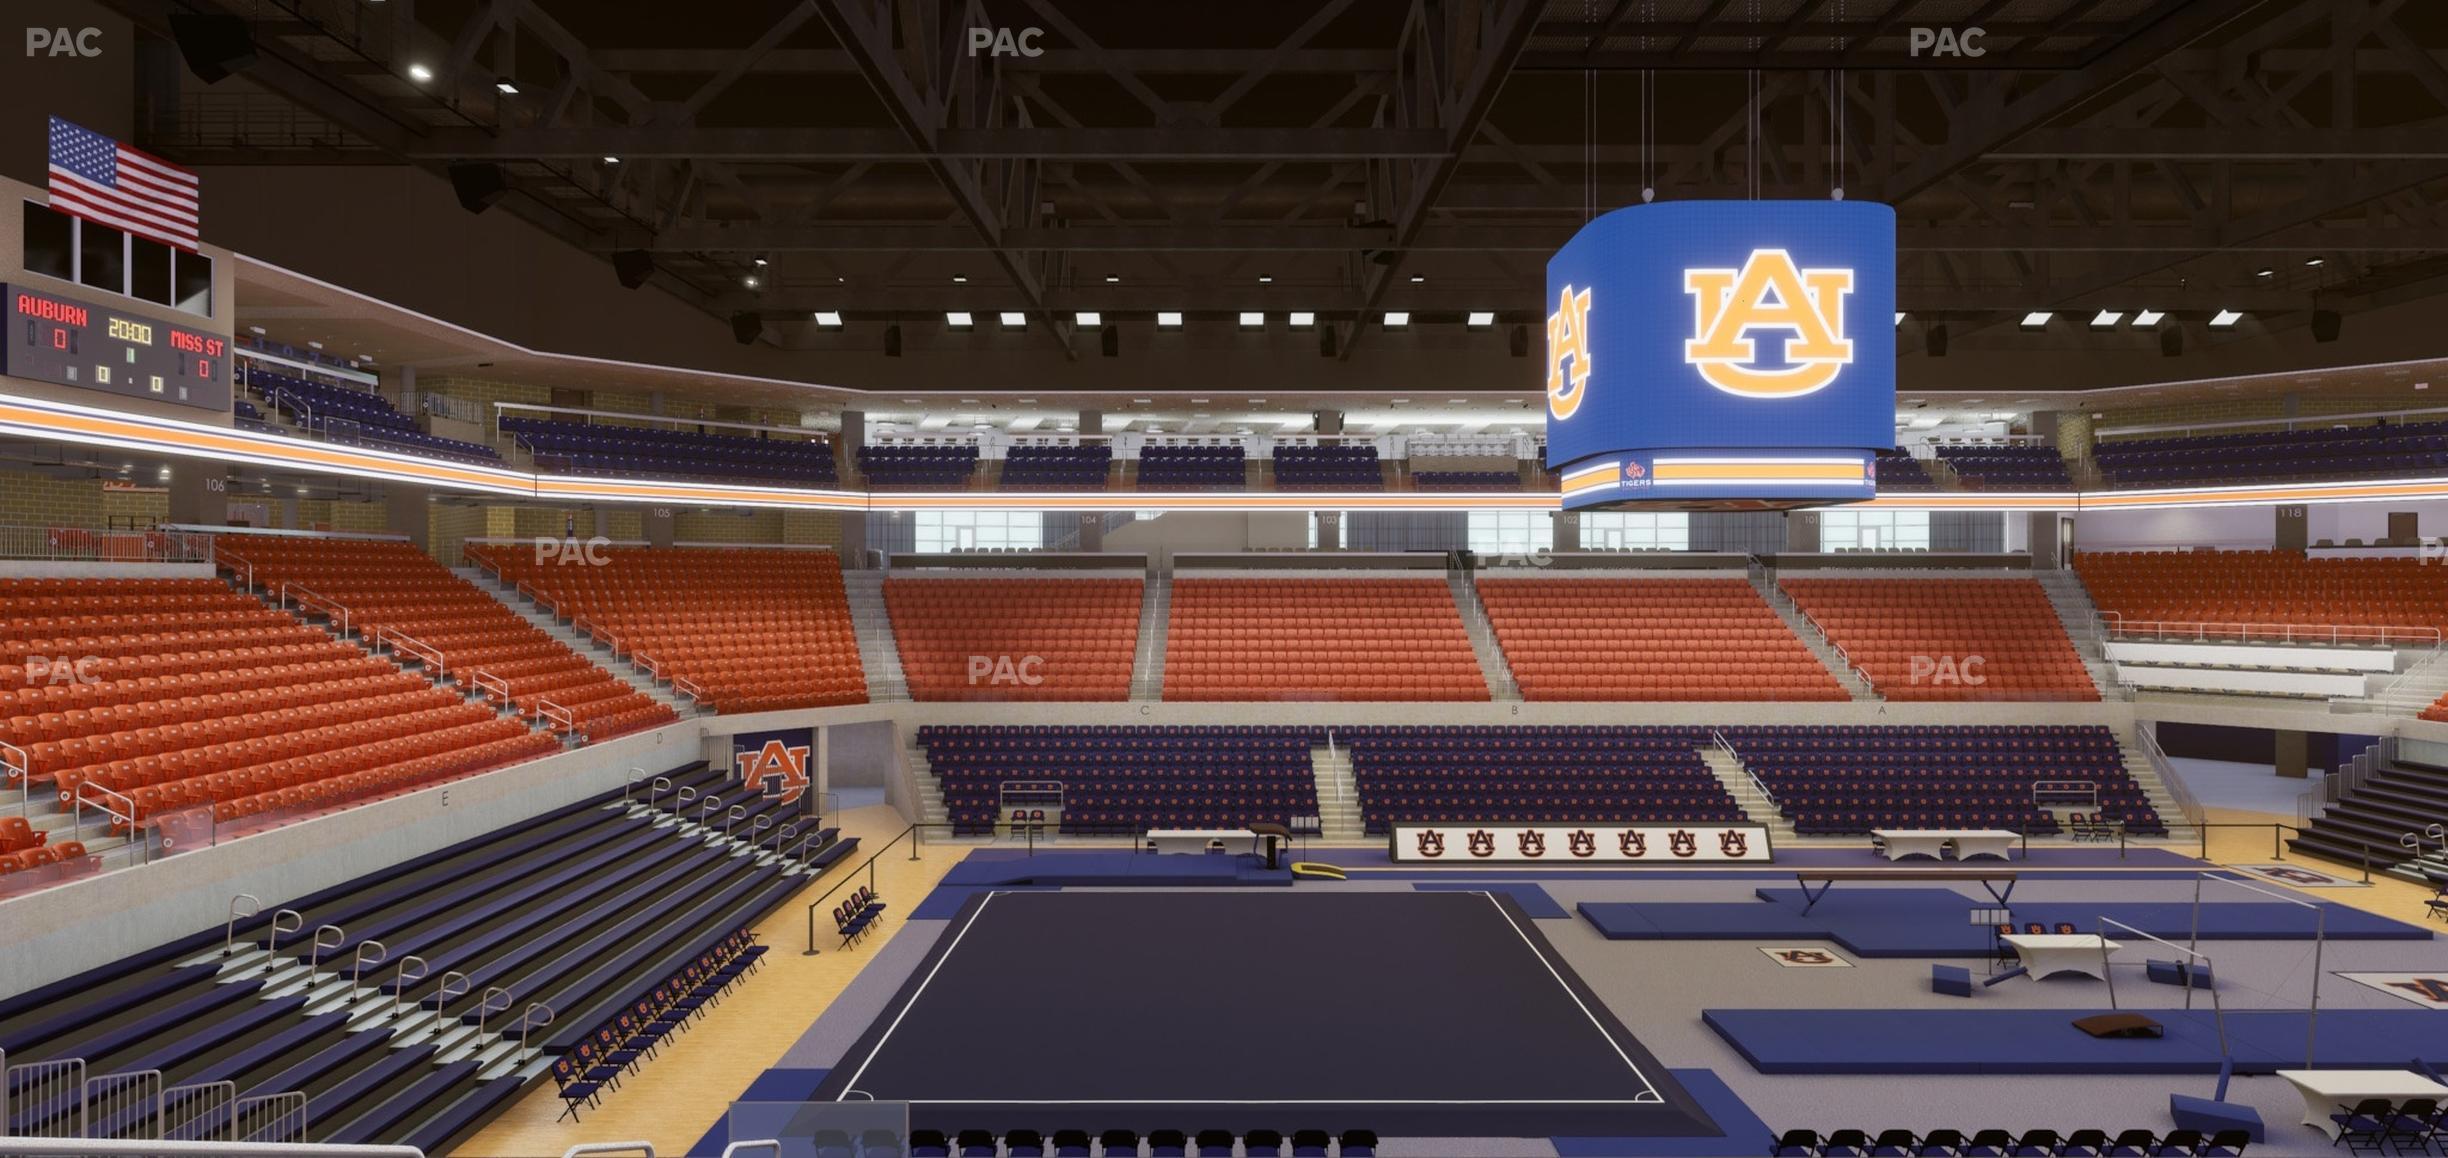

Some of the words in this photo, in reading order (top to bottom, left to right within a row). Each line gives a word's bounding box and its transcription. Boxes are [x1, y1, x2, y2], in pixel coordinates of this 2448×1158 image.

[18, 294, 88, 328] AUBURN
[108, 317, 152, 346] 20:00
[54, 328, 67, 349] 0
[170, 329, 203, 354] MISS
[206, 338, 224, 358] ST
[98, 366, 109, 383] 0
[199, 360, 209, 378] 0
[152, 376, 161, 392] 0
[205, 478, 225, 492] 106
[653, 508, 671, 518] 105
[2281, 508, 2302, 518] 118
[1081, 515, 1097, 525] 104
[1322, 515, 1337, 525] 103
[1563, 515, 1578, 525] 102
[1804, 515, 1819, 524] 101
[1140, 705, 1150, 716] C
[1511, 705, 1518, 716] B
[1878, 705, 1886, 715] A
[657, 733, 663, 744] D
[441, 791, 449, 807] E
